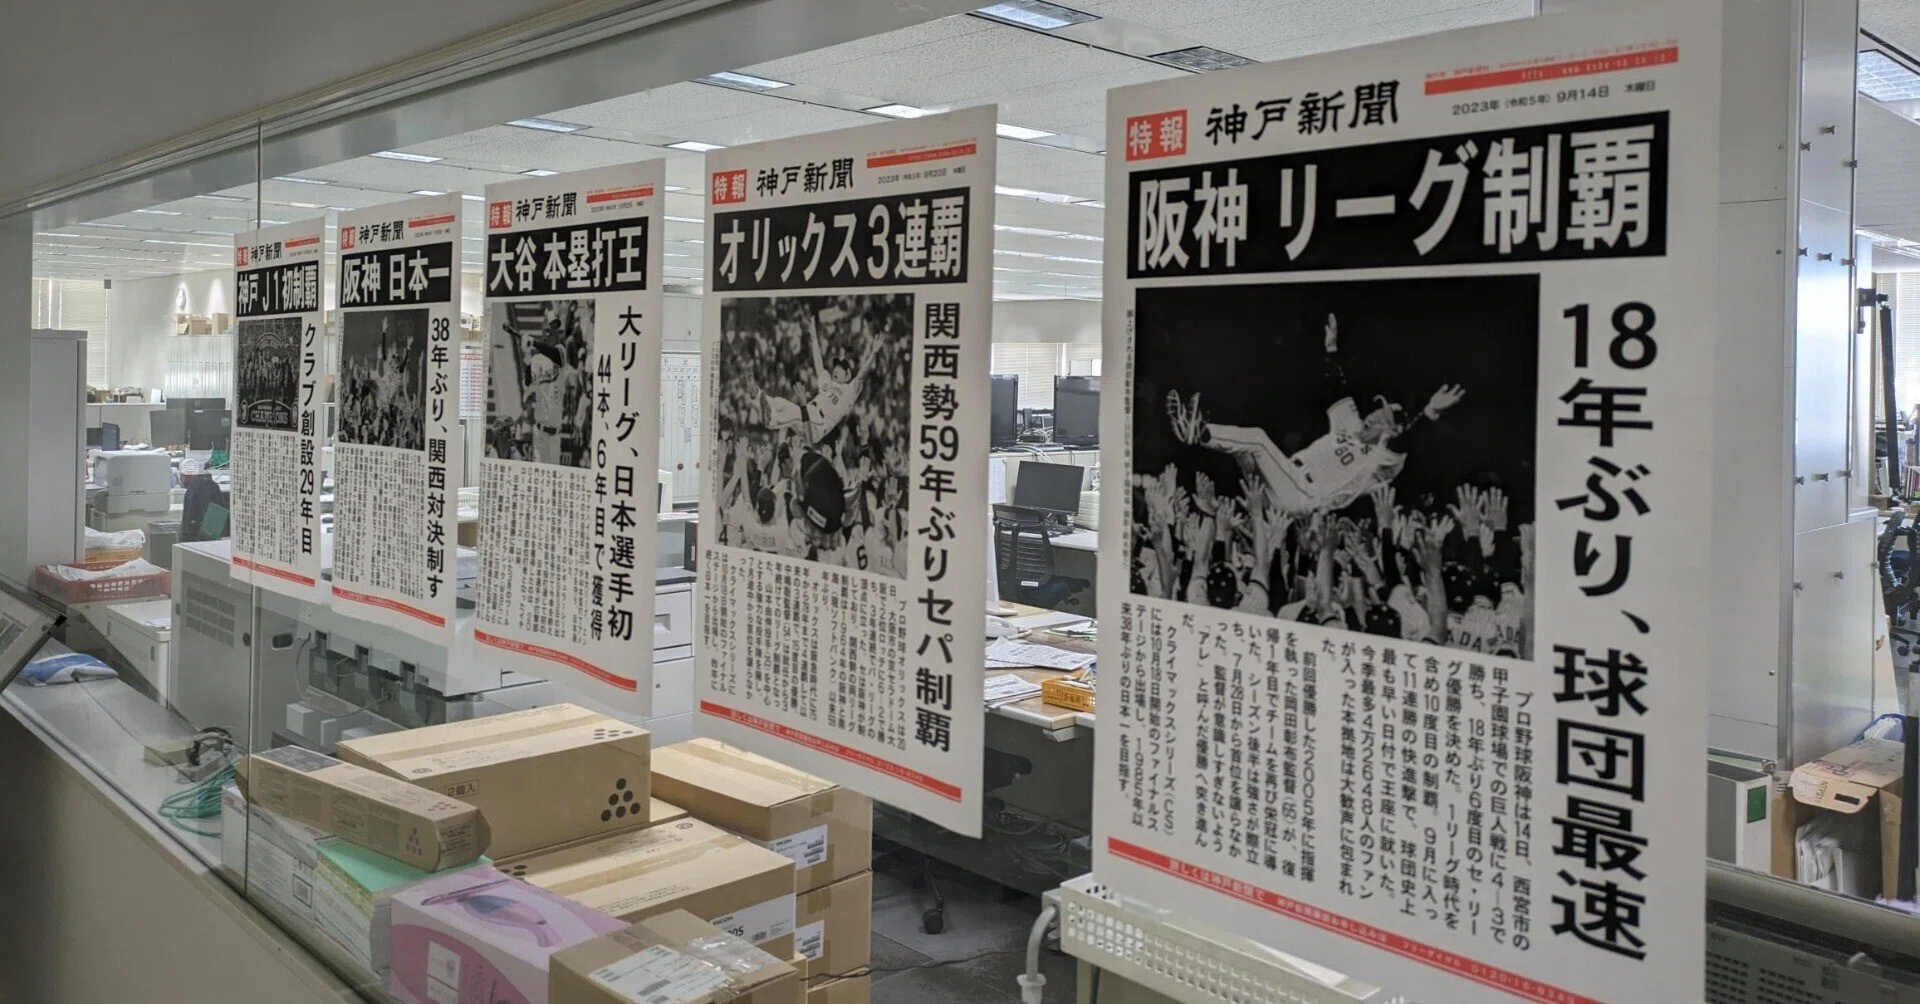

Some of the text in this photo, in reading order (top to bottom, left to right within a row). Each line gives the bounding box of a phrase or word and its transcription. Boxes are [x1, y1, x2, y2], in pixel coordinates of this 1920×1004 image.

[1204, 80, 1400, 147] 神戸新聞
[1452, 101, 1500, 116] 2023年
[1556, 86, 1609, 103] 9月14日
[1624, 80, 1656, 93] 木曜日
[1129, 113, 1185, 154] 特報
[516, 193, 577, 222] 神戸新聞
[714, 175, 745, 200] 特報
[756, 157, 855, 198] 神戸新聞
[1137, 124, 1655, 272] 阪神 リーグ制覇
[251, 241, 282, 262] 神戸新聞
[358, 220, 404, 245] 神戸新聞
[490, 225, 643, 292] 大谷 本塁打王
[719, 196, 965, 285] オリックス3連覇
[238, 274, 258, 314] 神戸
[342, 250, 450, 304] 阪神 日本一
[300, 323, 316, 555] クラブ創設29年目
[426, 318, 450, 598] 38年ぶり、関西対決制す
[590, 354, 612, 642] 44本、6年目で獲得
[607, 305, 643, 641] 大リーグ、日本選手初
[915, 302, 960, 752] 関西勢59年ぶりセパ制覇
[1551, 301, 1659, 962] 18年ぶり、球団最速
[447, 782, 476, 797] 2個入
[1512, 691, 1534, 951] プロ野球阪神は14日、西宮市の
